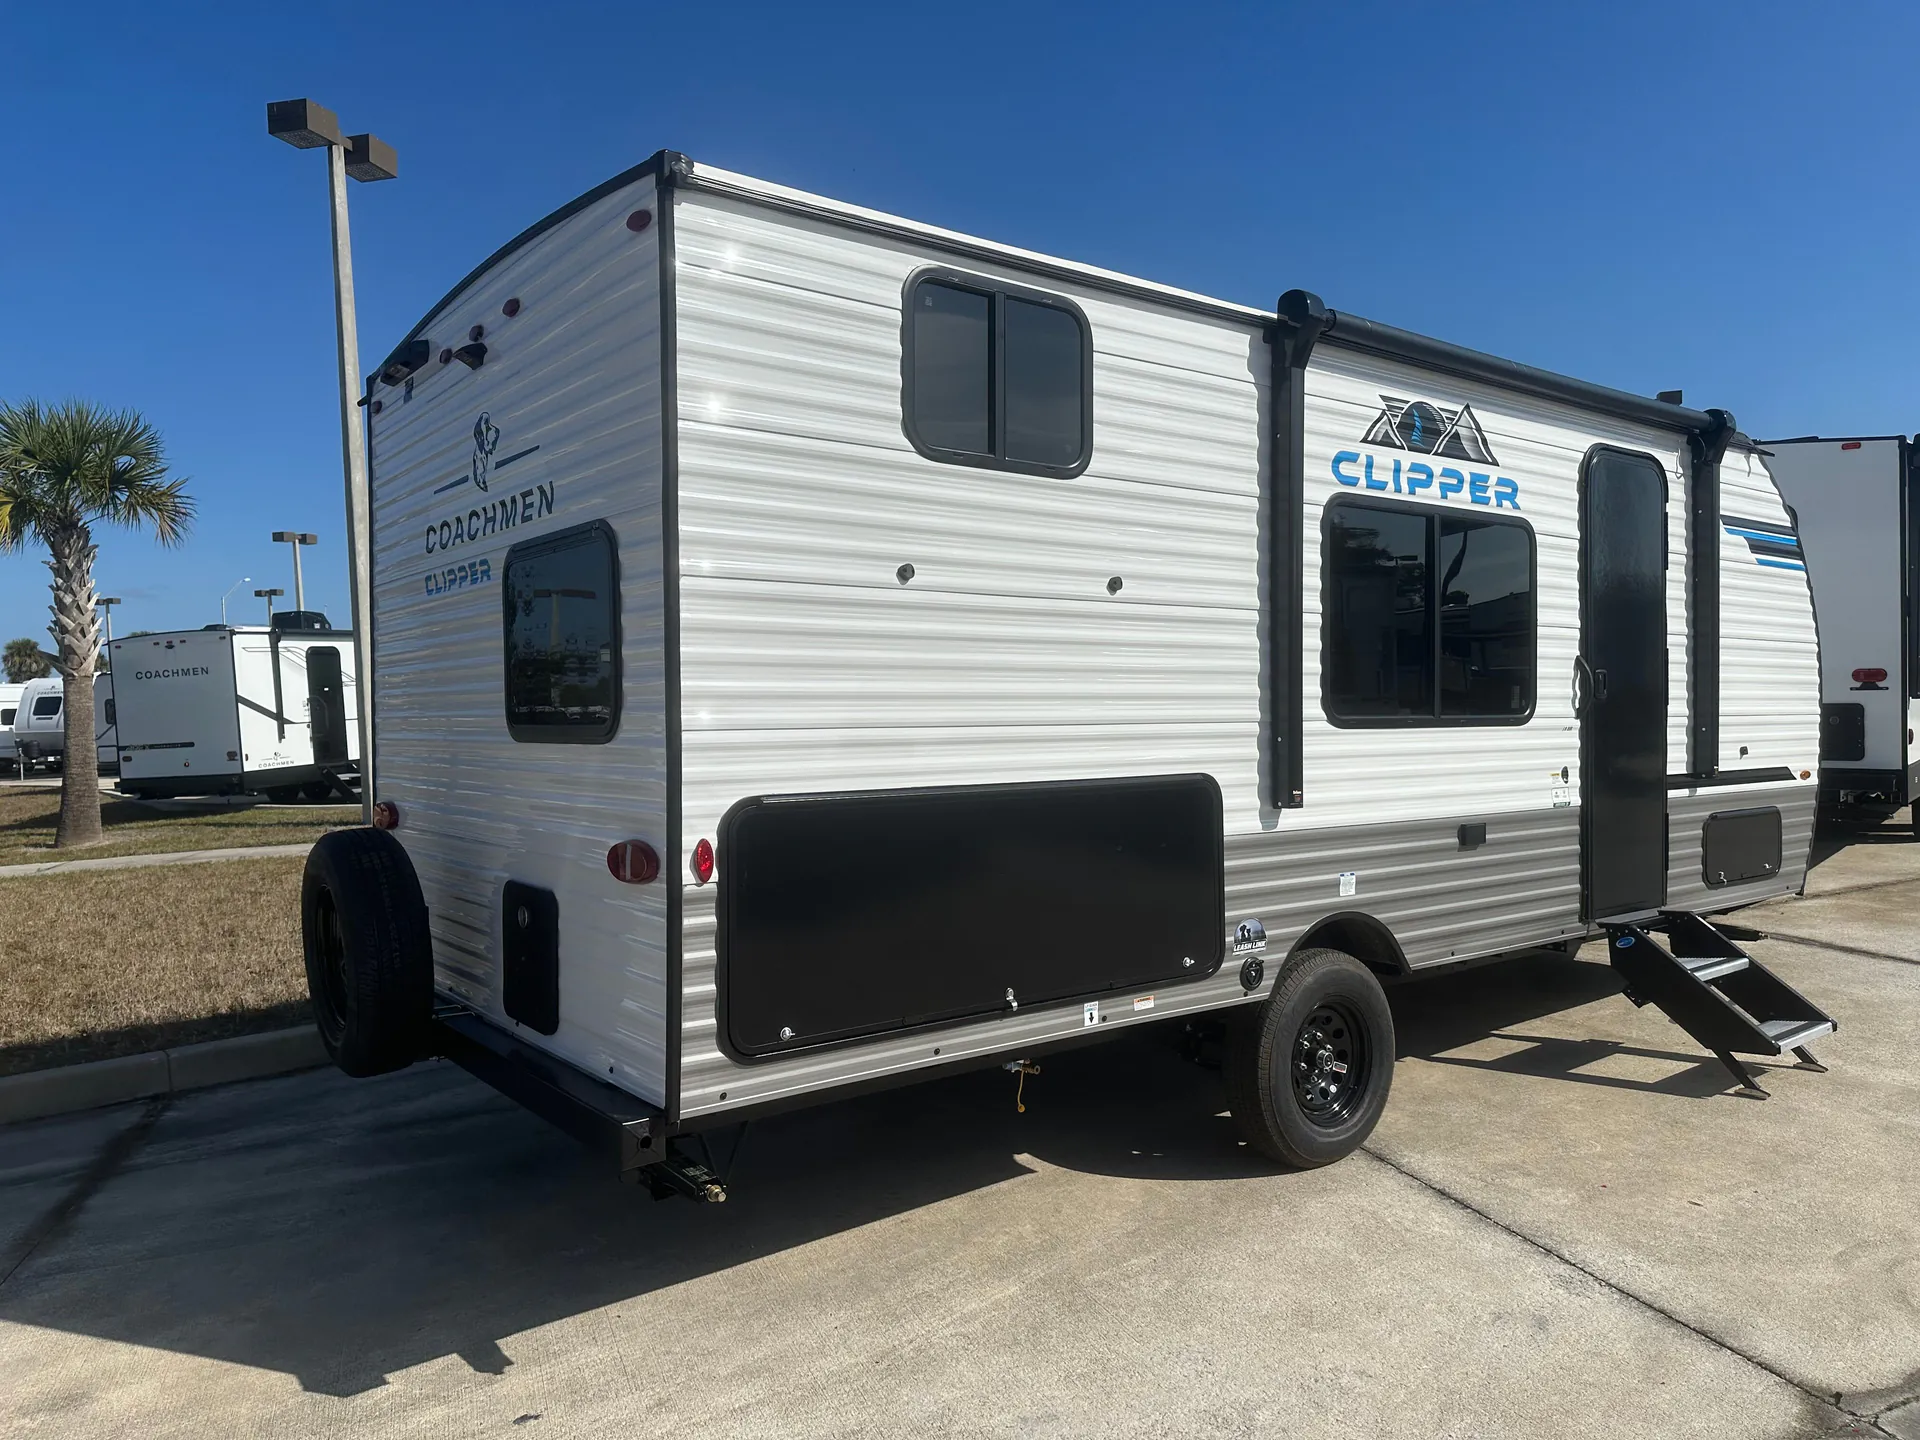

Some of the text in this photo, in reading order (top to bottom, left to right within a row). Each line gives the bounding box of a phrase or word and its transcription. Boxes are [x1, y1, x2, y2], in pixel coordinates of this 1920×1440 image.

[1331, 450, 1521, 511] CLIPPER
[424, 481, 555, 554] COACHMEN
[424, 558, 492, 596] CLIPPER
[135, 666, 209, 680] COACHMEN
[258, 760, 295, 769] COACHMEN
[1233, 943, 1252, 951] LEASH
